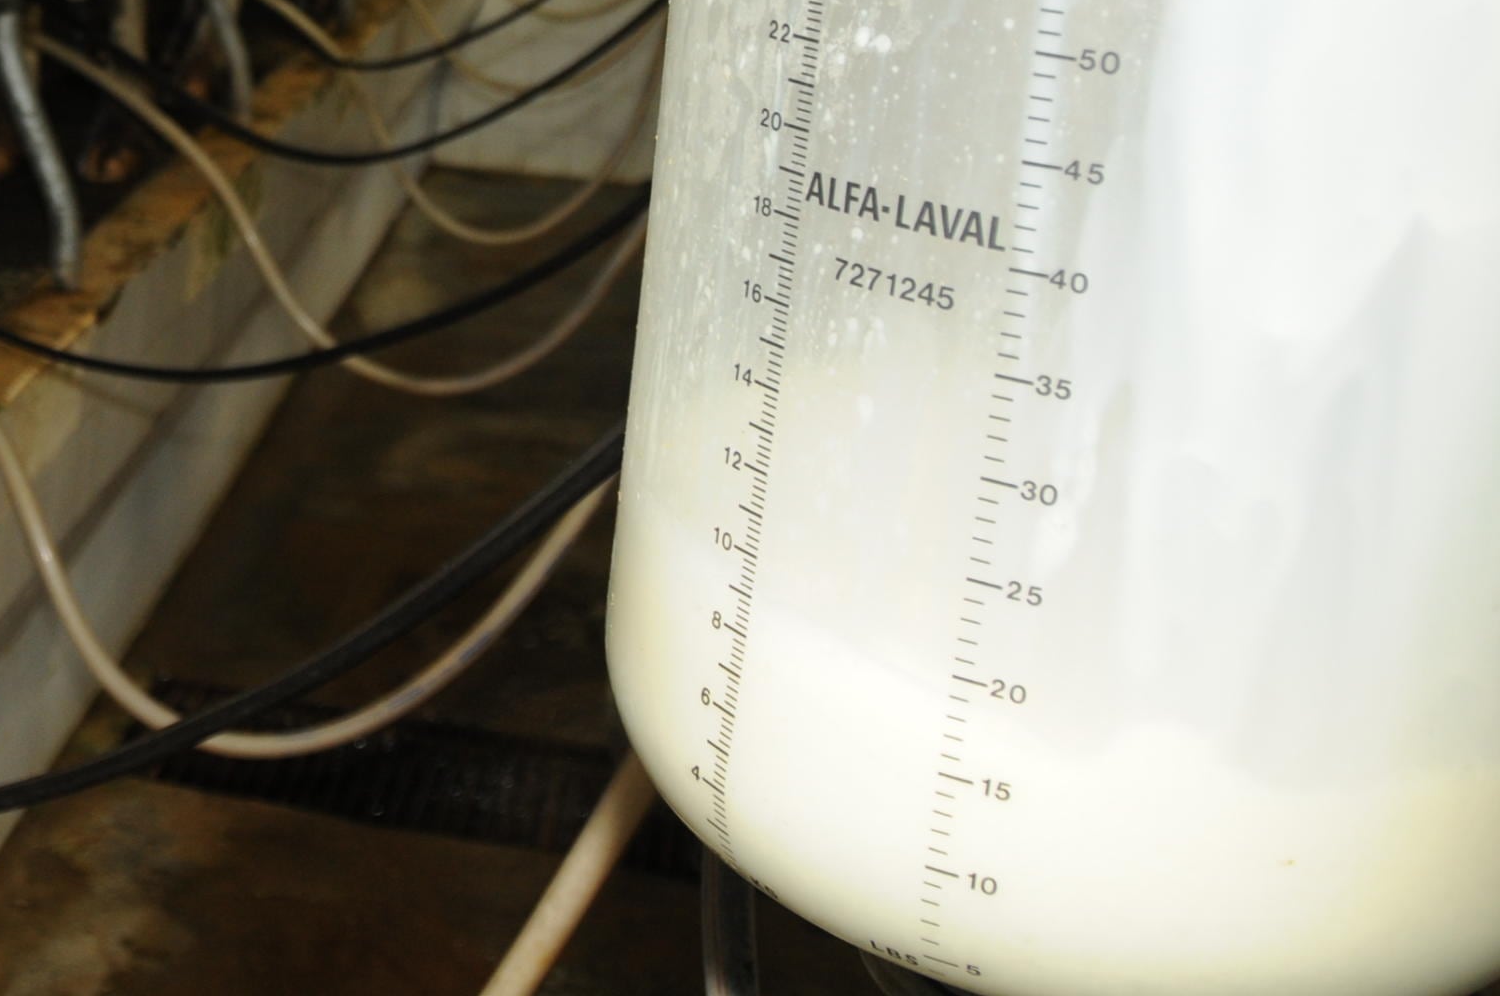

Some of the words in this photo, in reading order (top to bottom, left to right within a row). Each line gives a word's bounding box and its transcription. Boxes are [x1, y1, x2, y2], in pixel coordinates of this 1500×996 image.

[768, 20, 791, 43] 22
[1078, 49, 1121, 75] 50
[760, 108, 783, 132] 20
[1064, 160, 1105, 186] 45
[753, 195, 771, 217] 18
[804, 171, 1007, 252] ALFA-LAVAL
[742, 280, 763, 304] 16
[833, 257, 955, 311] 7271245
[1049, 268, 1089, 295] 40
[732, 363, 753, 386] 14
[1035, 374, 1072, 402] 35
[722, 446, 742, 469] 12
[1019, 480, 1058, 507] 30
[712, 527, 733, 550] 10
[1006, 580, 1043, 607] 25
[711, 611, 722, 629] 8
[701, 687, 711, 705] 6
[989, 678, 1027, 705] 20
[690, 765, 701, 780] 4
[981, 778, 1012, 801] 15
[967, 872, 998, 897] 10
[966, 964, 982, 977] 5
